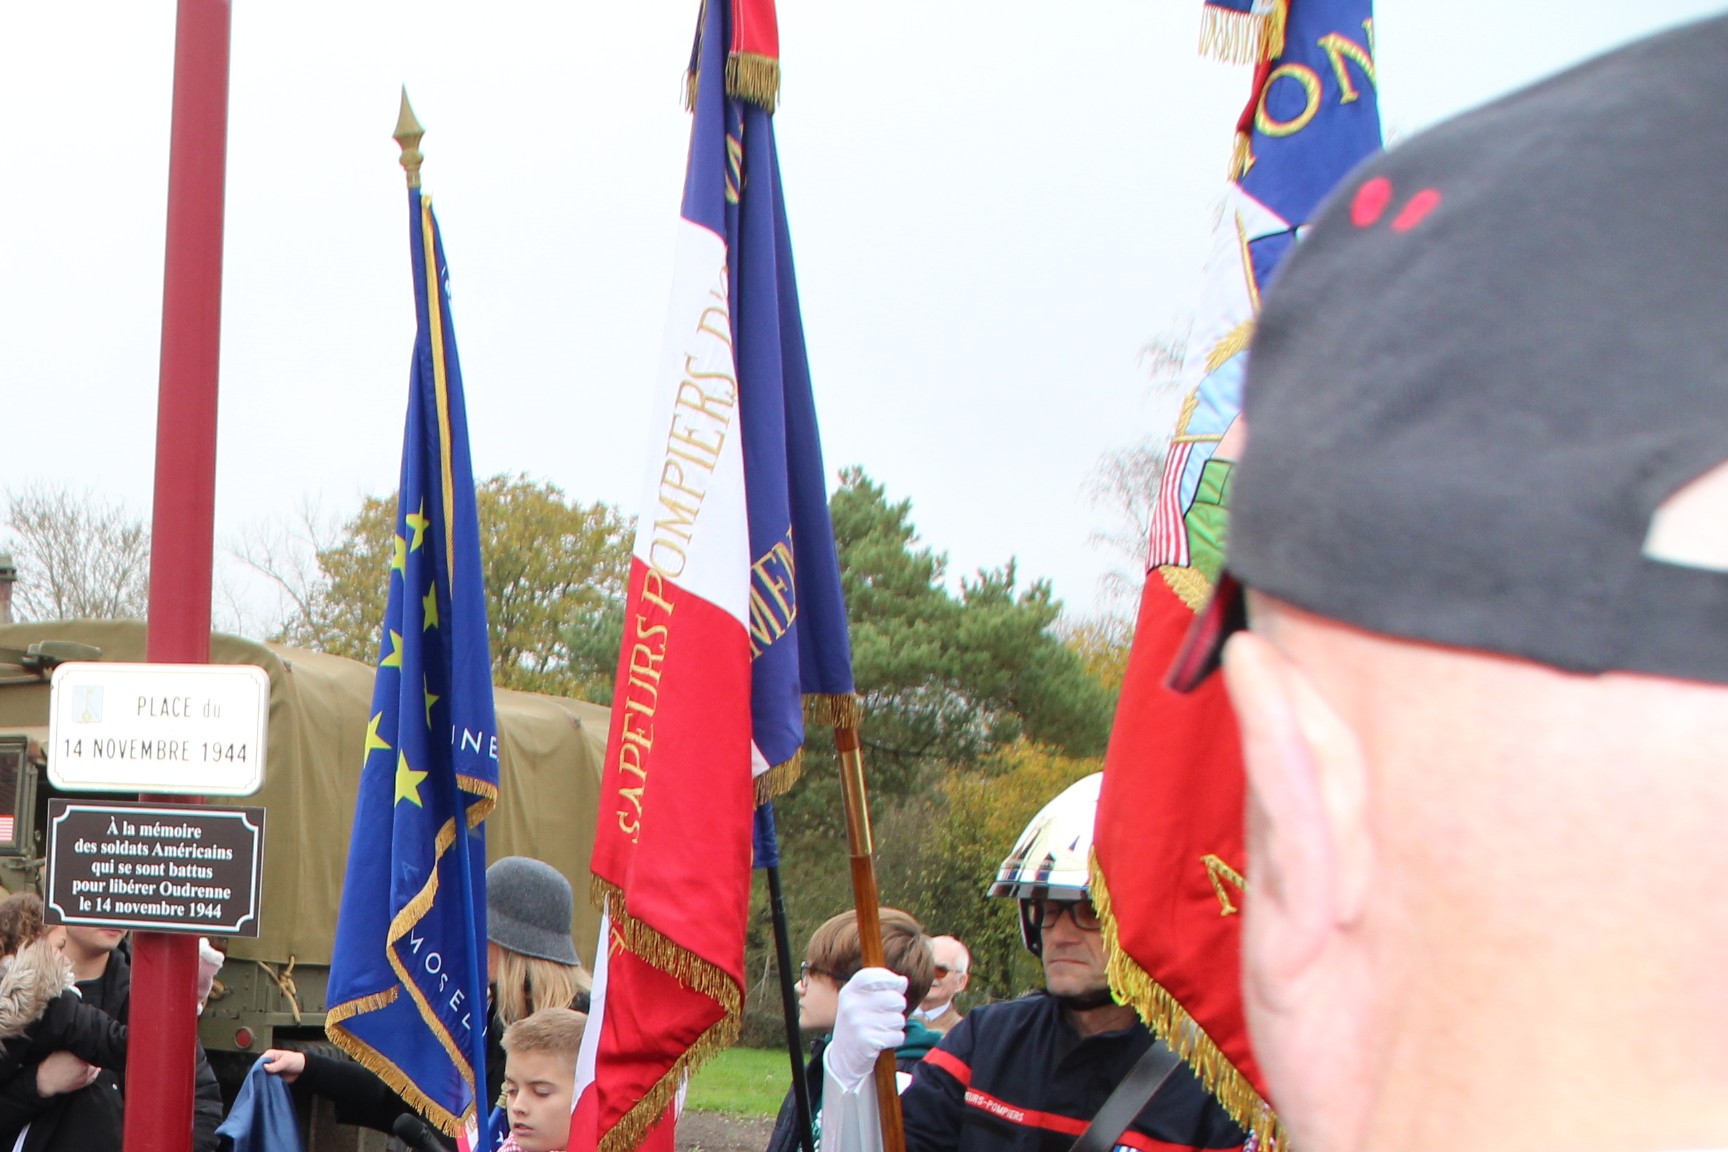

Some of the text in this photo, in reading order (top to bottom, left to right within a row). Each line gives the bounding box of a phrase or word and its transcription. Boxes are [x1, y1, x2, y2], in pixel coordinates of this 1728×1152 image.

[1244, 17, 1376, 178] ON
[640, 353, 738, 617] POMPIERS
[137, 695, 221, 718] PLACE du
[617, 614, 668, 844] SAPEURS
[64, 738, 247, 763] 14 NOVEMBRE 1944
[106, 816, 202, 839] À la mémoire
[74, 838, 233, 860] des soldats Américains
[91, 859, 213, 879] qui se sont battus
[72, 878, 232, 899] pour libérer Oudrenne
[79, 896, 222, 919] le 14 novembre 1944
